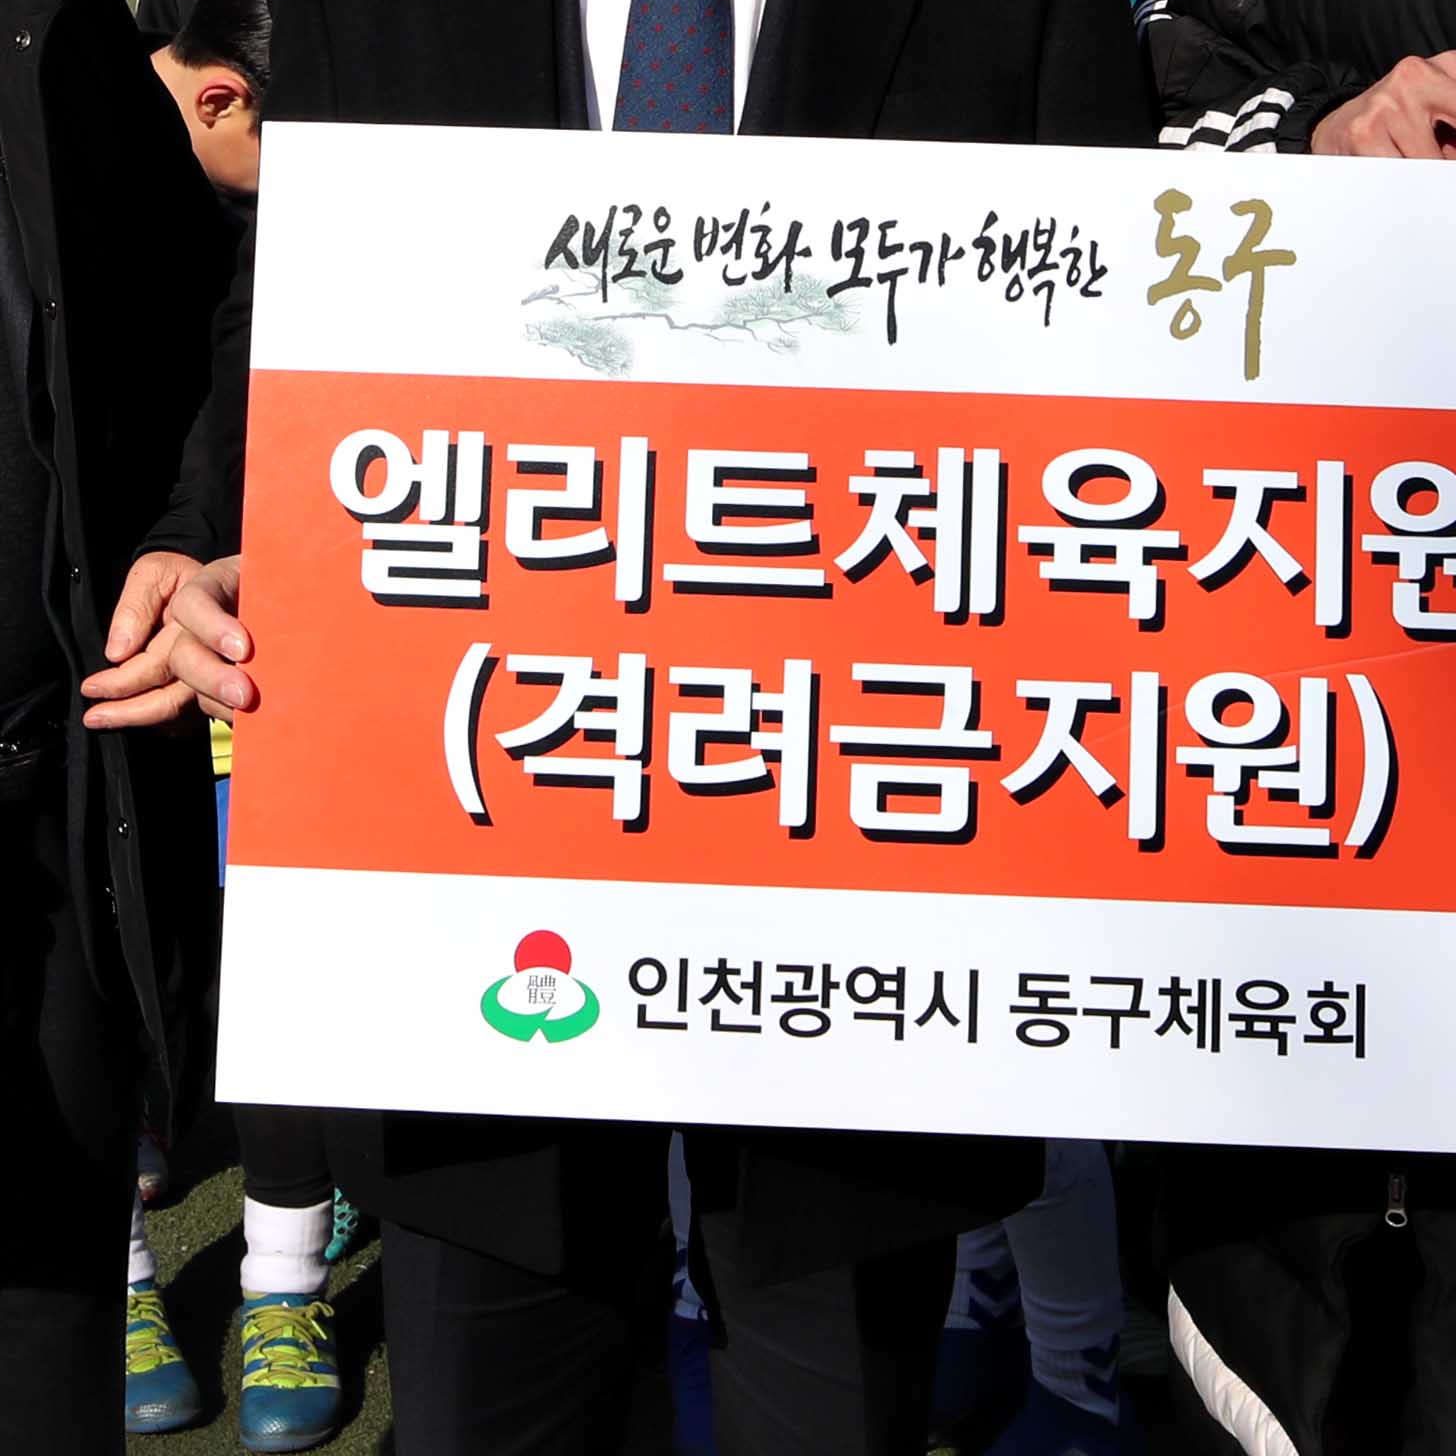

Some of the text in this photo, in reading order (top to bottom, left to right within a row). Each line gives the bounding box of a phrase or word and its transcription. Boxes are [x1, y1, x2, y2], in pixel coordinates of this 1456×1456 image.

[544, 187, 1298, 382] 새로운 변화 모두가 행복한 동구
[443, 641, 1400, 860] (격려금지원)
[628, 957, 1366, 1059] 인천광역시 동구체육회
